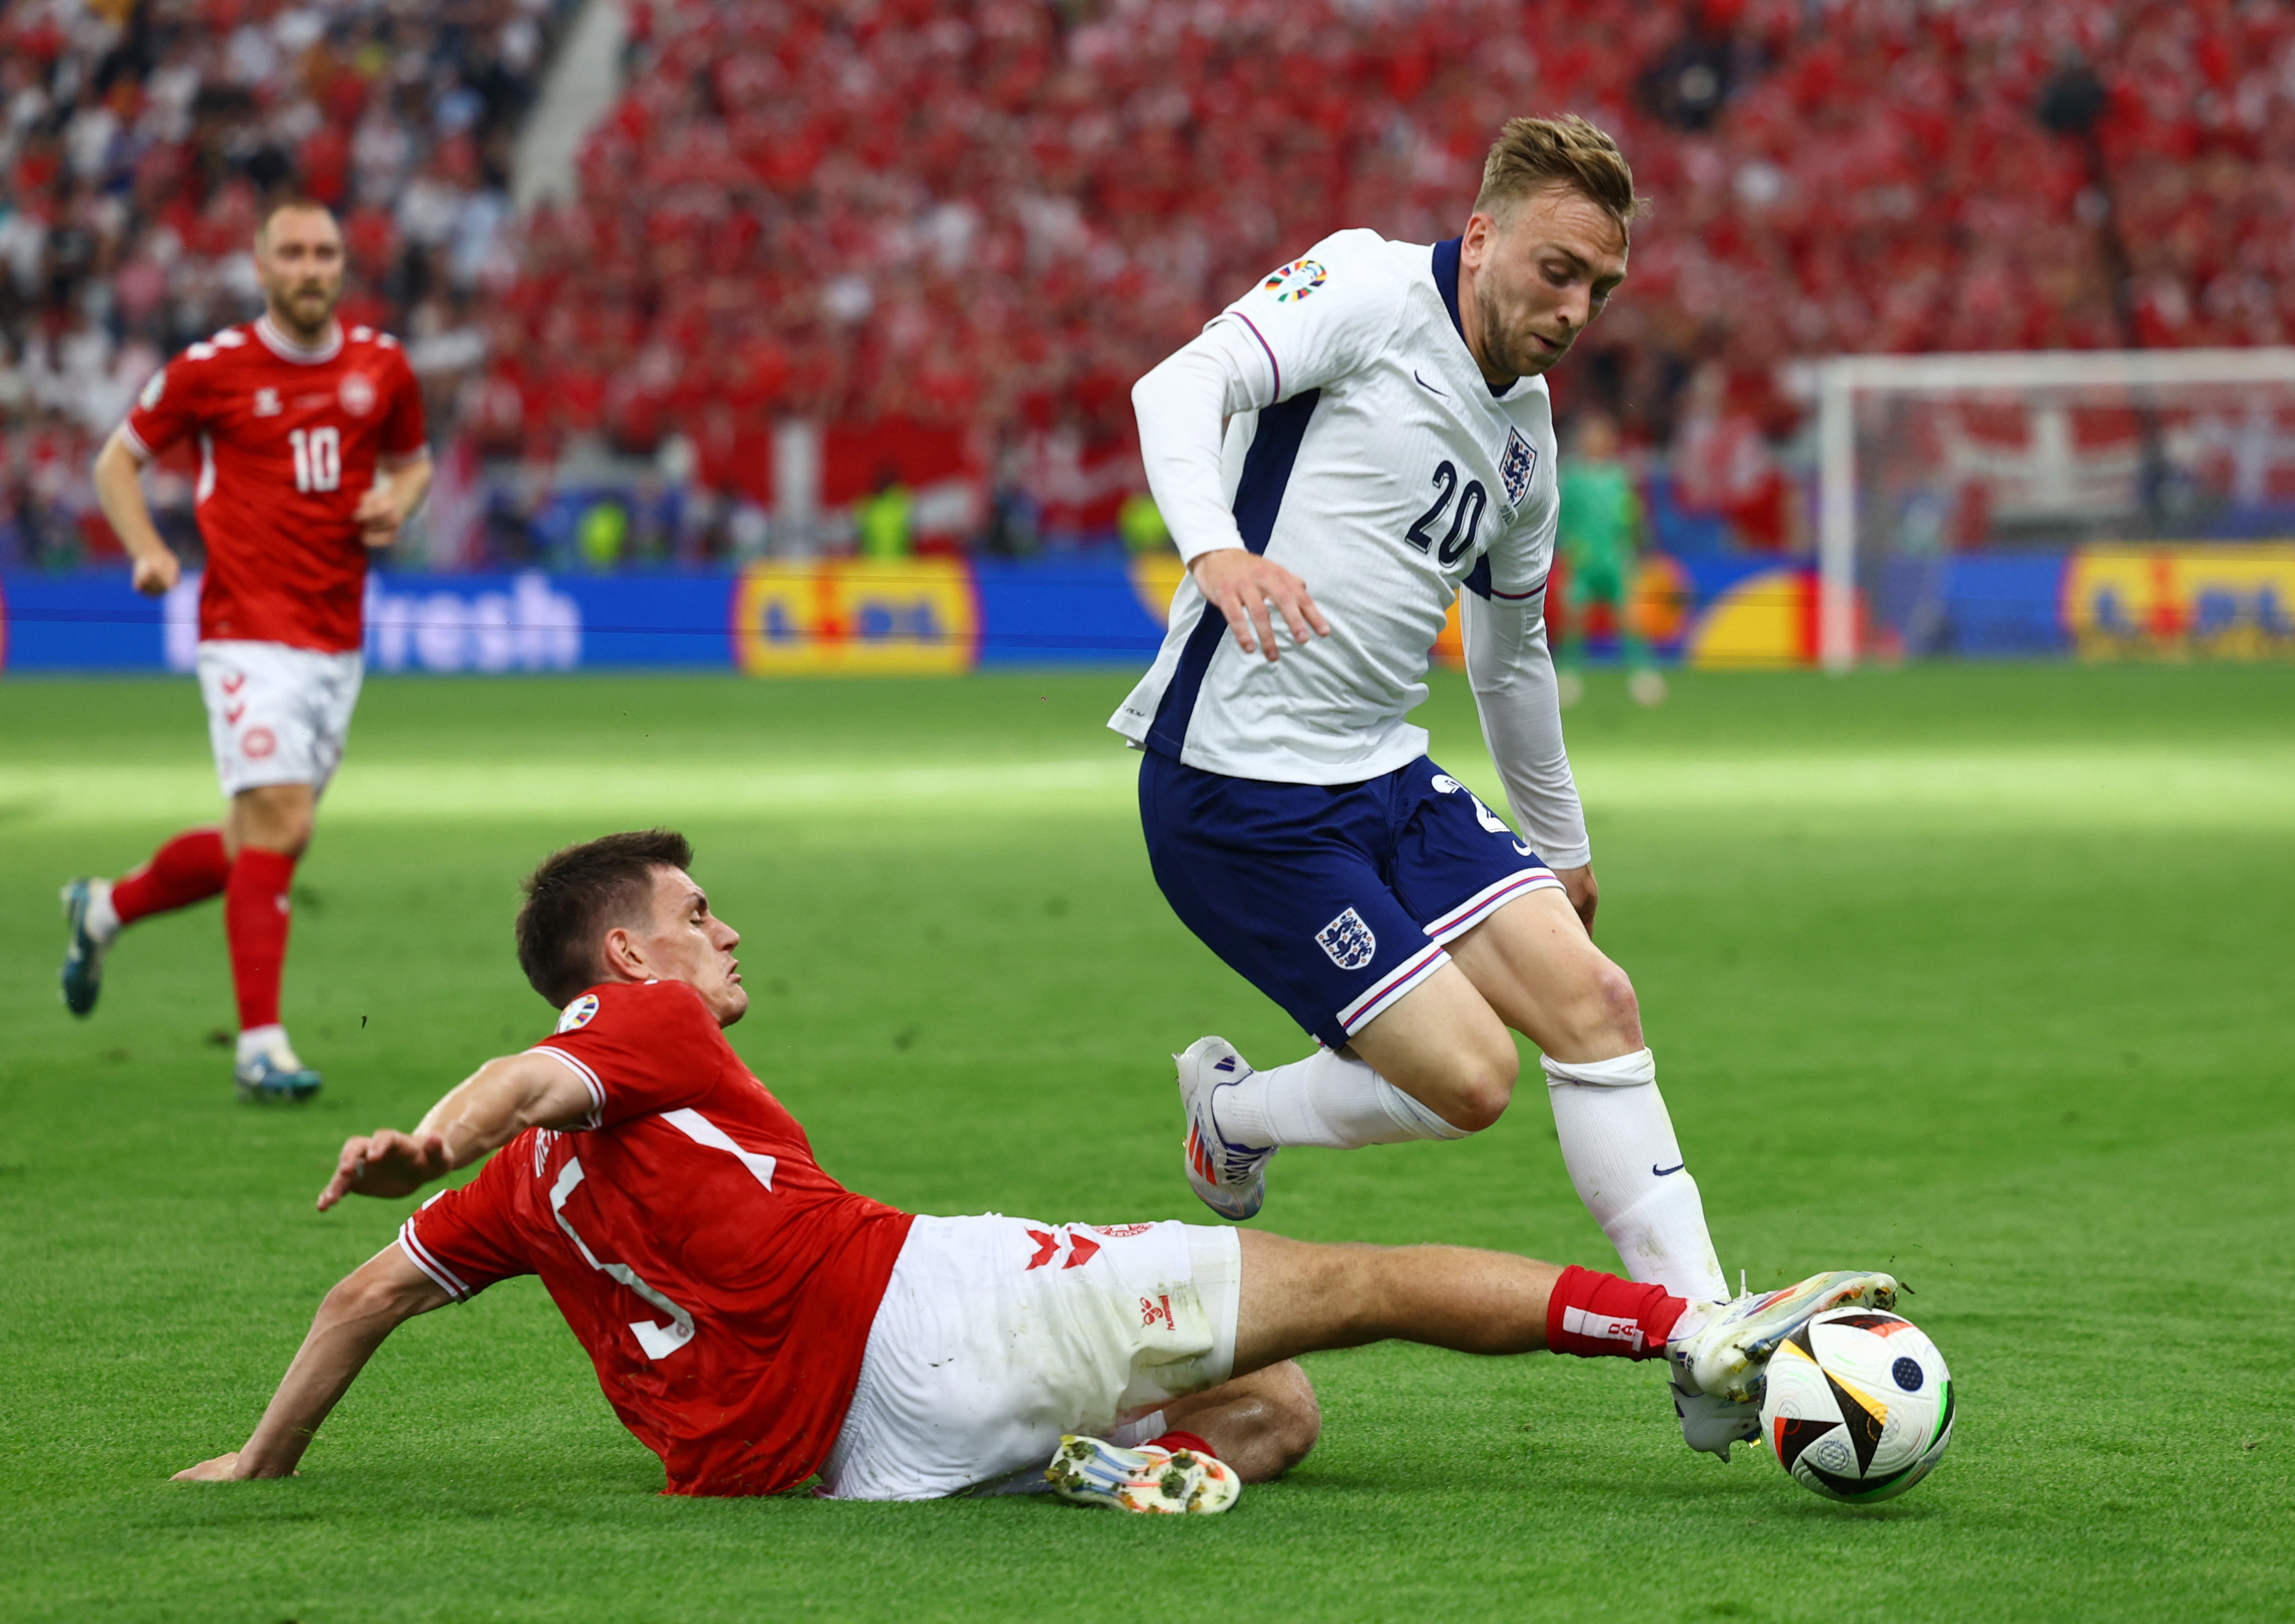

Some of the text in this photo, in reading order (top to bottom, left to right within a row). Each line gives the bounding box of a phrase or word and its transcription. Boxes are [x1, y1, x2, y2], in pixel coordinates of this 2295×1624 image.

[288, 426, 341, 493] 10
[1405, 460, 1486, 568] 20
[549, 1156, 695, 1360] 5
[1158, 1295, 1175, 1331] hummel
